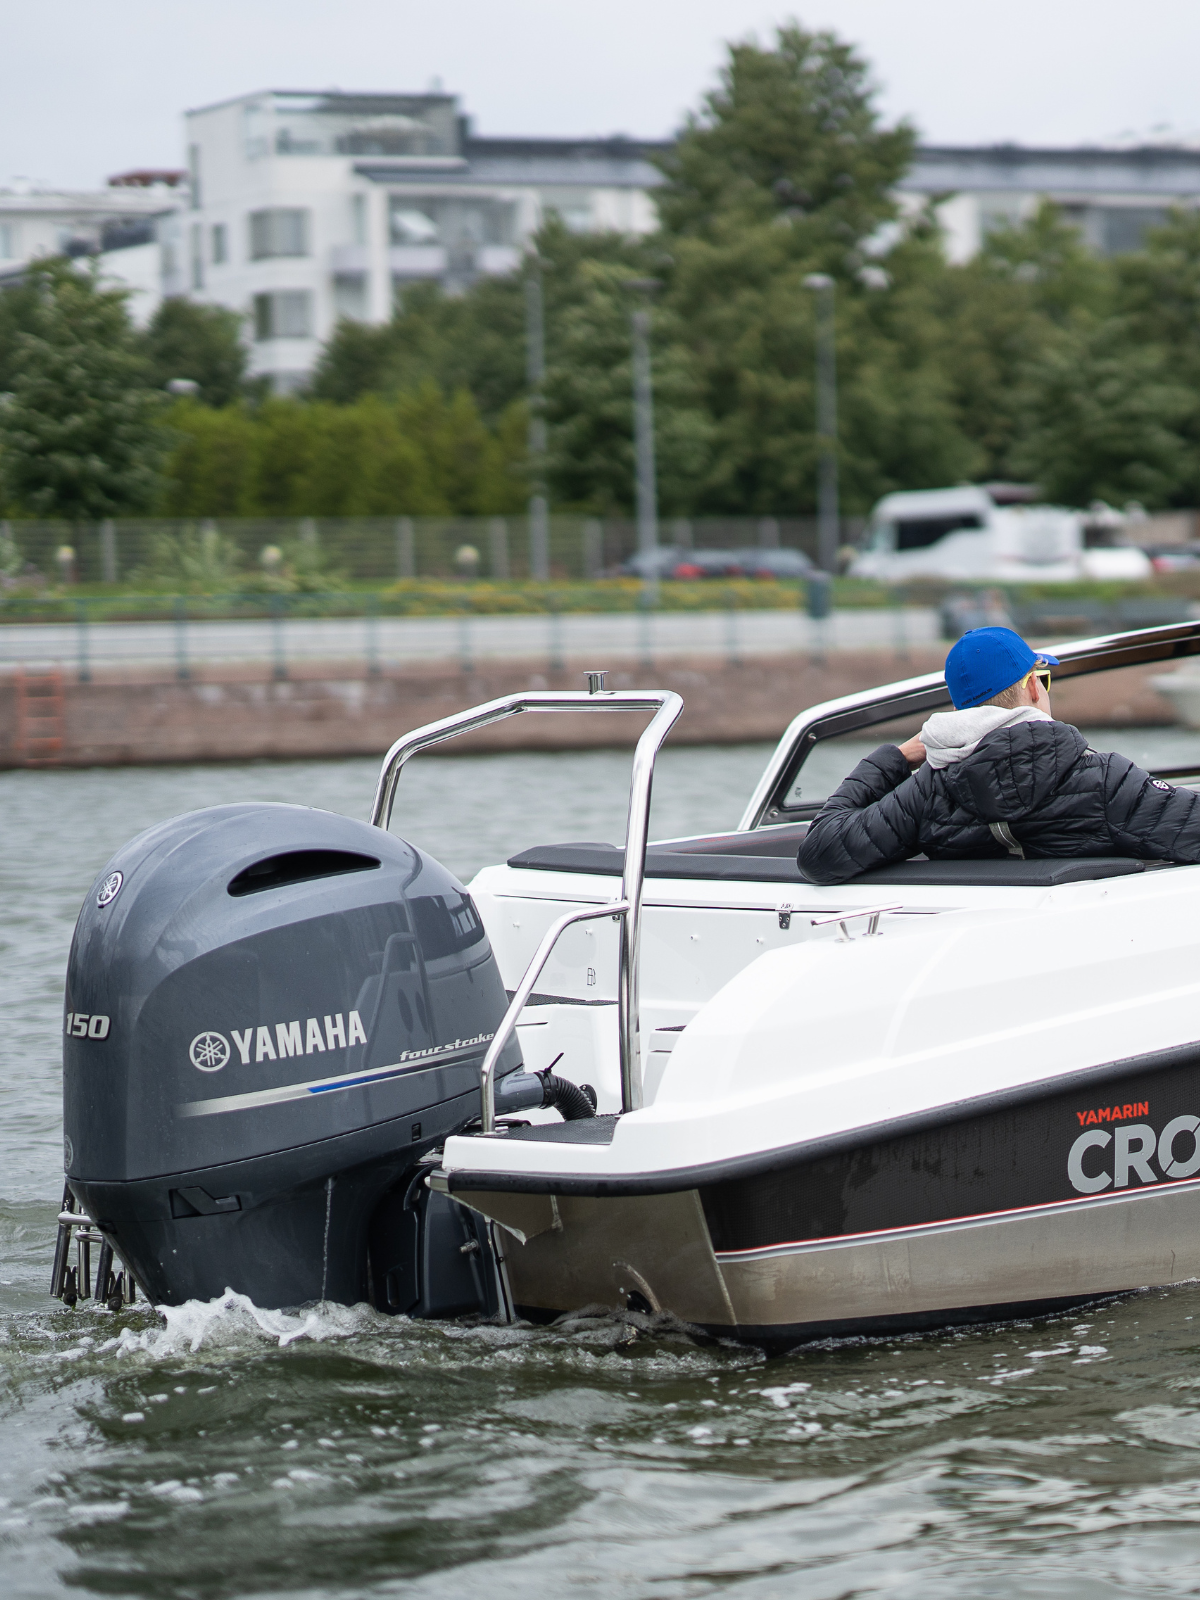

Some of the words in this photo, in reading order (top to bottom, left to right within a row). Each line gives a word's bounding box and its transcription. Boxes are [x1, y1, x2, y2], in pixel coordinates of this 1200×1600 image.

[66, 1012, 110, 1038] 150
[230, 1010, 368, 1065] YAMAHA
[1076, 1101, 1149, 1126] YAMARIN
